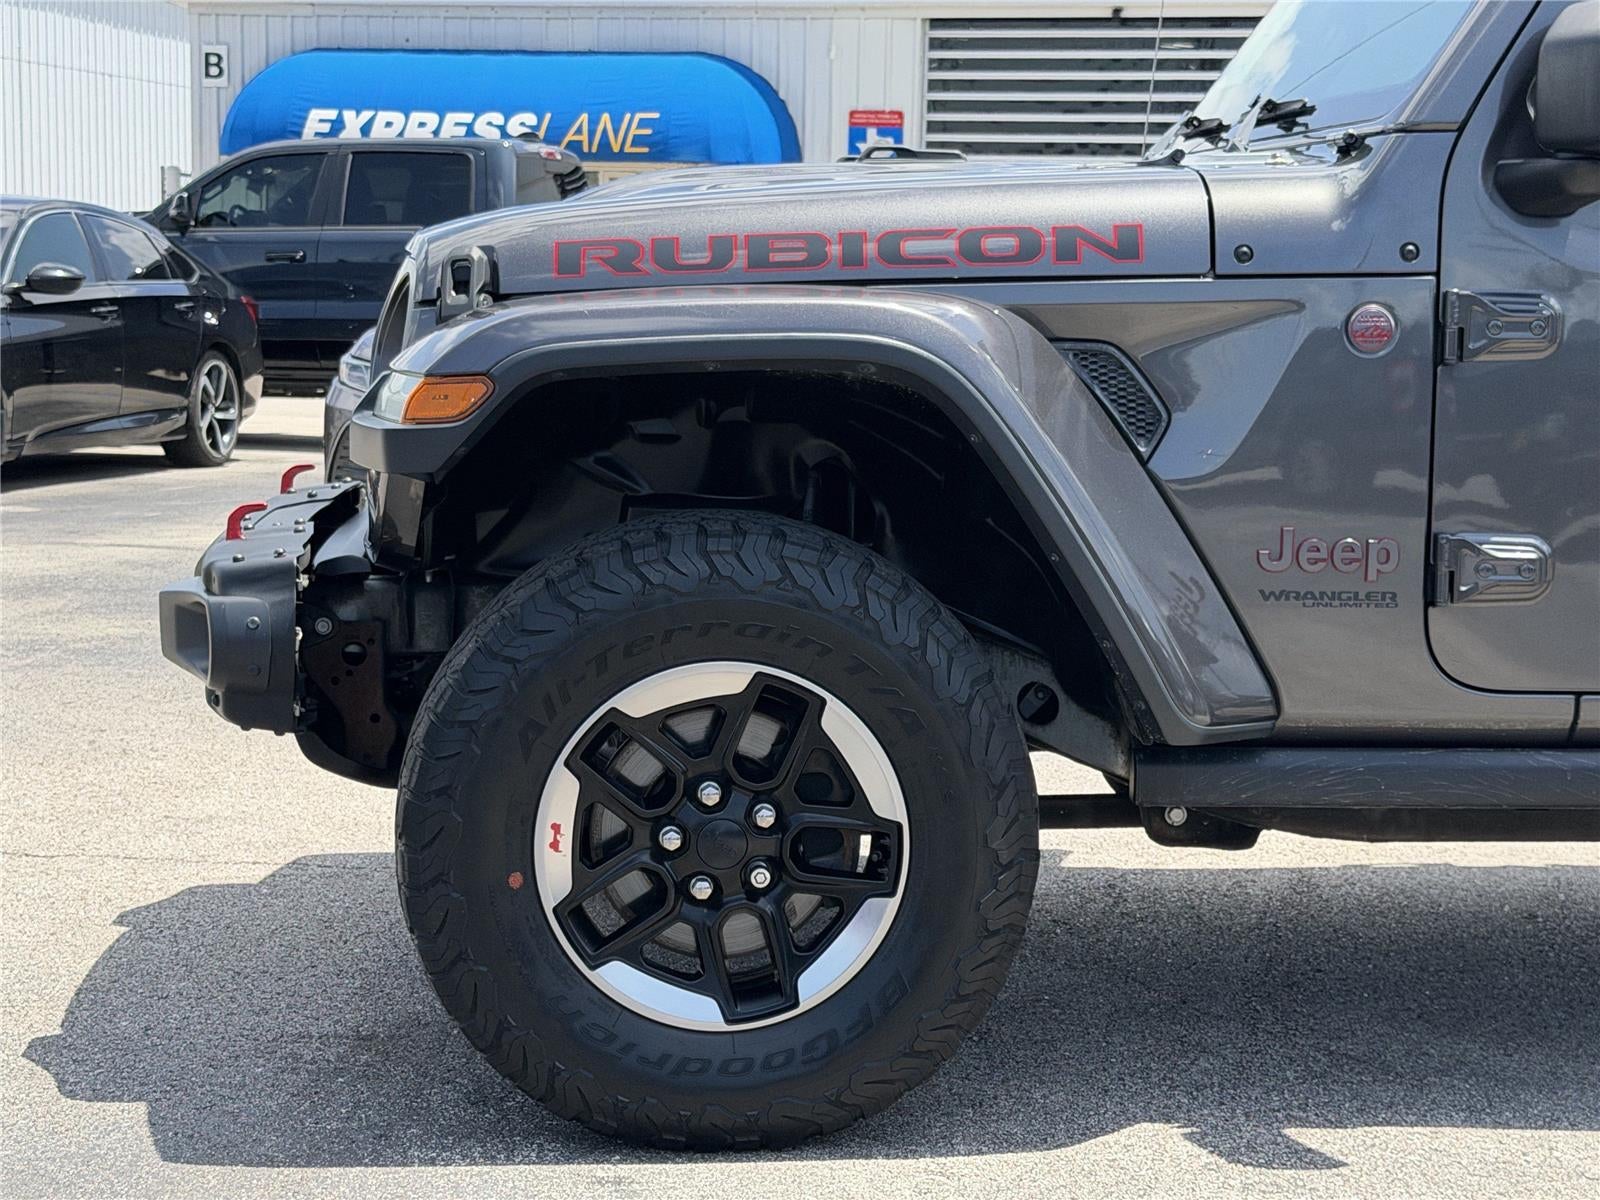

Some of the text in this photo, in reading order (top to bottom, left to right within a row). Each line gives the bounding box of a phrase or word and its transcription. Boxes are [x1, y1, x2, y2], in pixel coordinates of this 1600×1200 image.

[203, 51, 224, 79] B
[552, 222, 1145, 279] RUBICON
[1256, 525, 1400, 583] Jeep
[1258, 588, 1398, 602] WRANGLER
[1302, 601, 1399, 609] UNLIMITED
